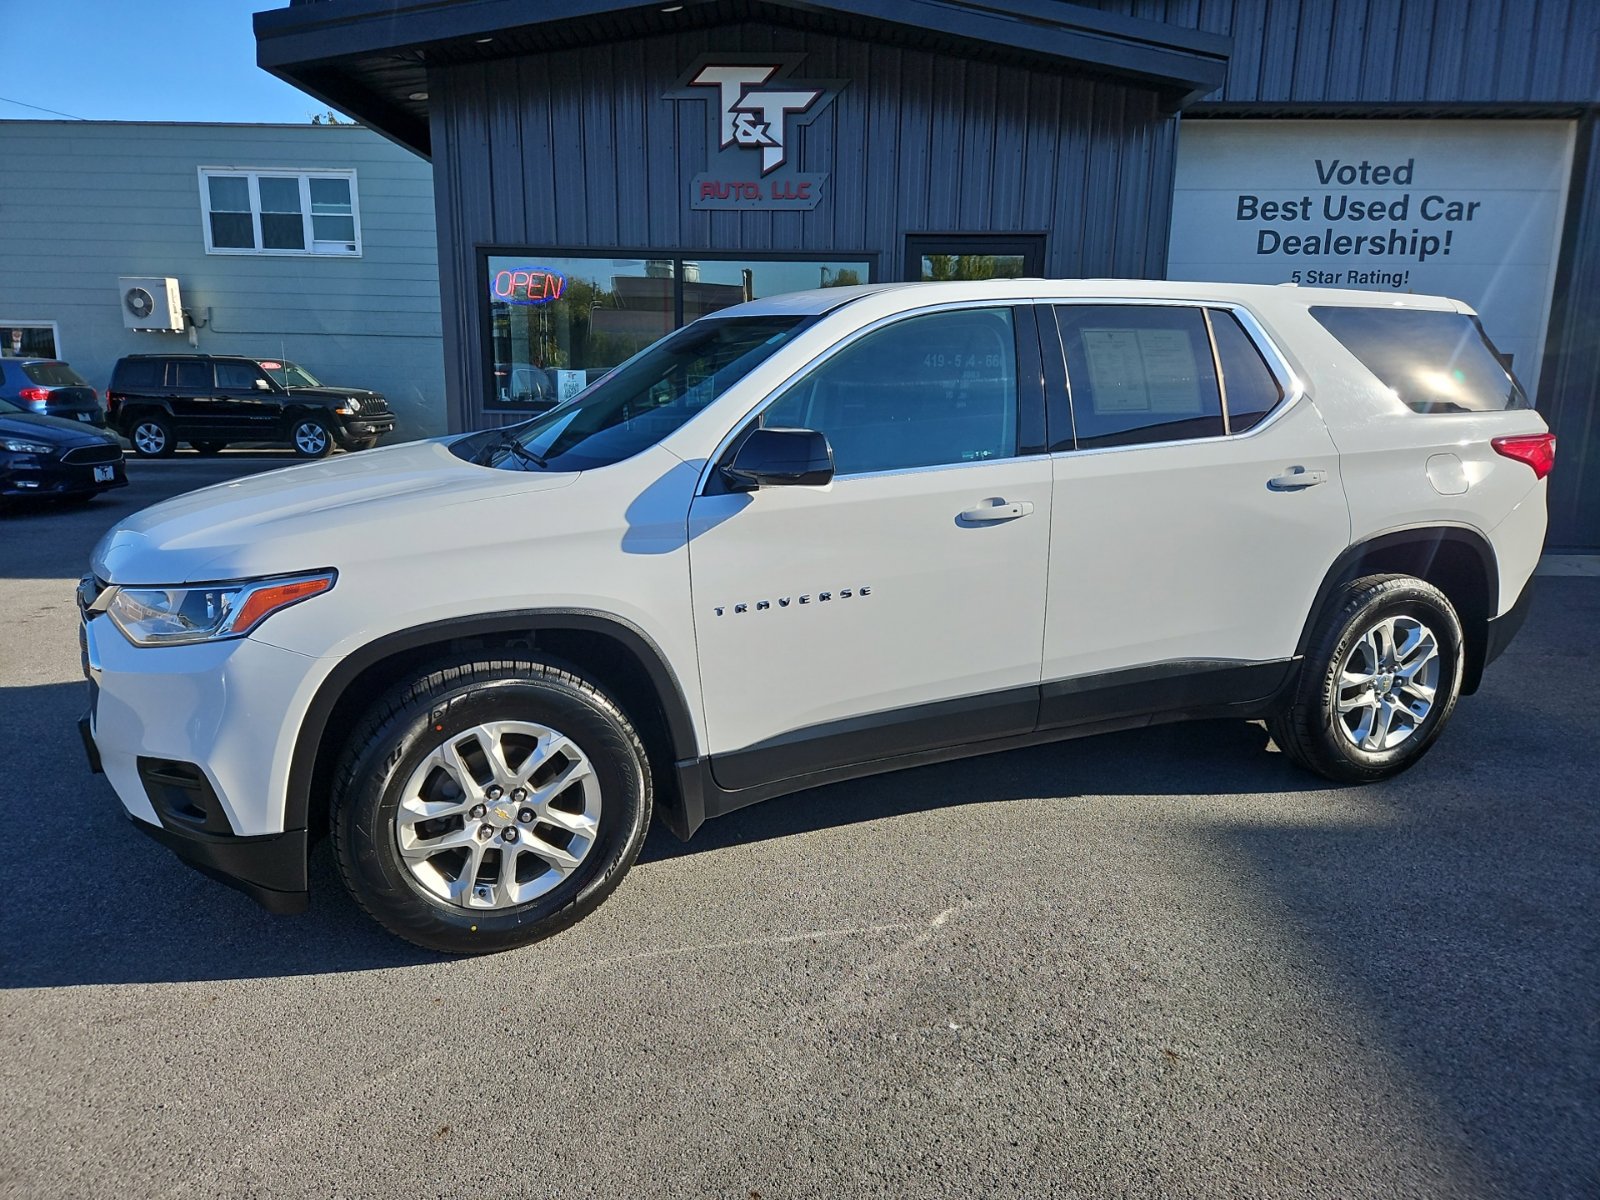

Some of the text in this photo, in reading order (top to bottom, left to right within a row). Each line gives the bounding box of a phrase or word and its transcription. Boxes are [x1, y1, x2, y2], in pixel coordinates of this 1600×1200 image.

[688, 65, 822, 176] T&T
[1314, 158, 1415, 186] Voted
[771, 180, 812, 199] LLC
[1236, 194, 1481, 222] Best Used Car
[1256, 228, 1453, 262] Dealership!
[495, 270, 564, 300] OPEN
[1291, 269, 1410, 288] 5 Star Rating!
[713, 586, 872, 617] TRAVERSE
